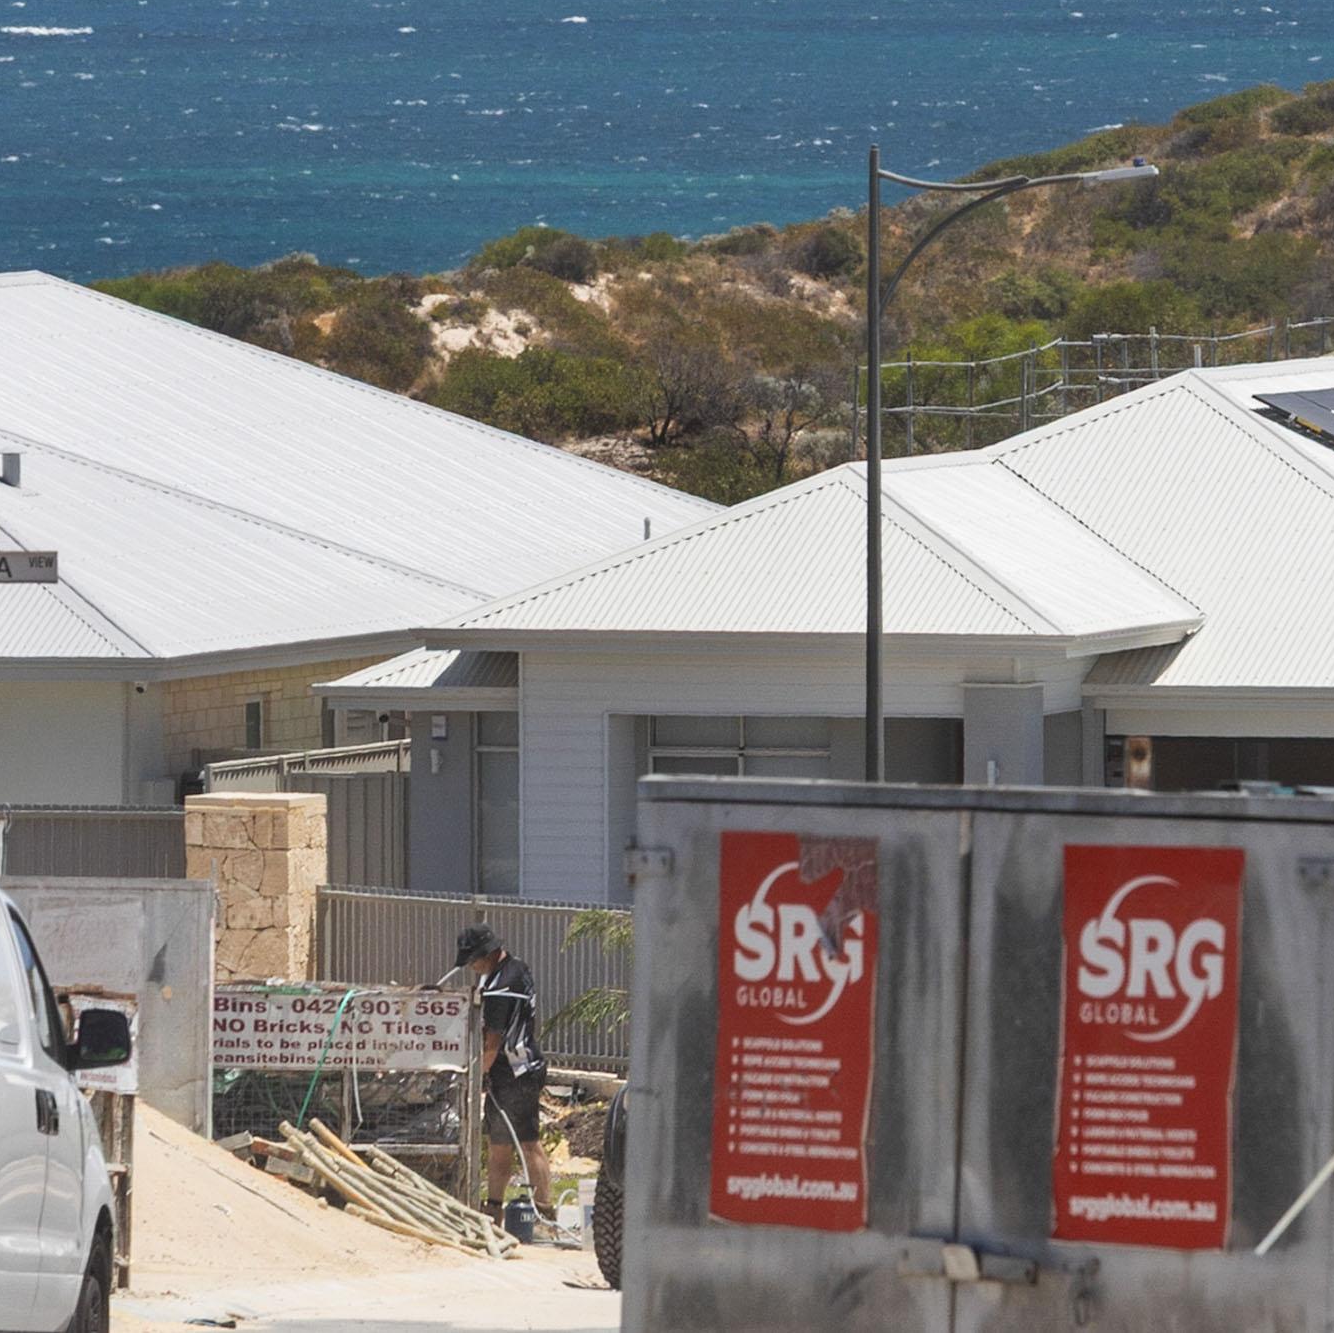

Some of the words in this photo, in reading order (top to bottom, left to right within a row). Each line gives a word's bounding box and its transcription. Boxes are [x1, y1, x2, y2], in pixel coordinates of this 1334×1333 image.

[28, 556, 54, 567] VIEW
[734, 902, 864, 985] SRG
[1078, 917, 1226, 1000] SRG
[213, 997, 267, 1013] Bins
[415, 1001, 460, 1016] 565
[736, 986, 807, 1008] GLOBAL
[1079, 1002, 1159, 1025] GLOBAL
[213, 1018, 245, 1033] NO
[253, 1019, 332, 1036] Bricks,
[340, 1021, 373, 1034] NO
[382, 1021, 436, 1035] Tiles
[257, 1038, 273, 1049] to
[280, 1038, 301, 1049] be
[308, 1038, 366, 1051] placed
[372, 1038, 425, 1051] inside
[432, 1040, 459, 1051] Bin
[727, 1172, 859, 1202] srgglobal.com.au
[1069, 1192, 1216, 1222] srgglobal.com.au
